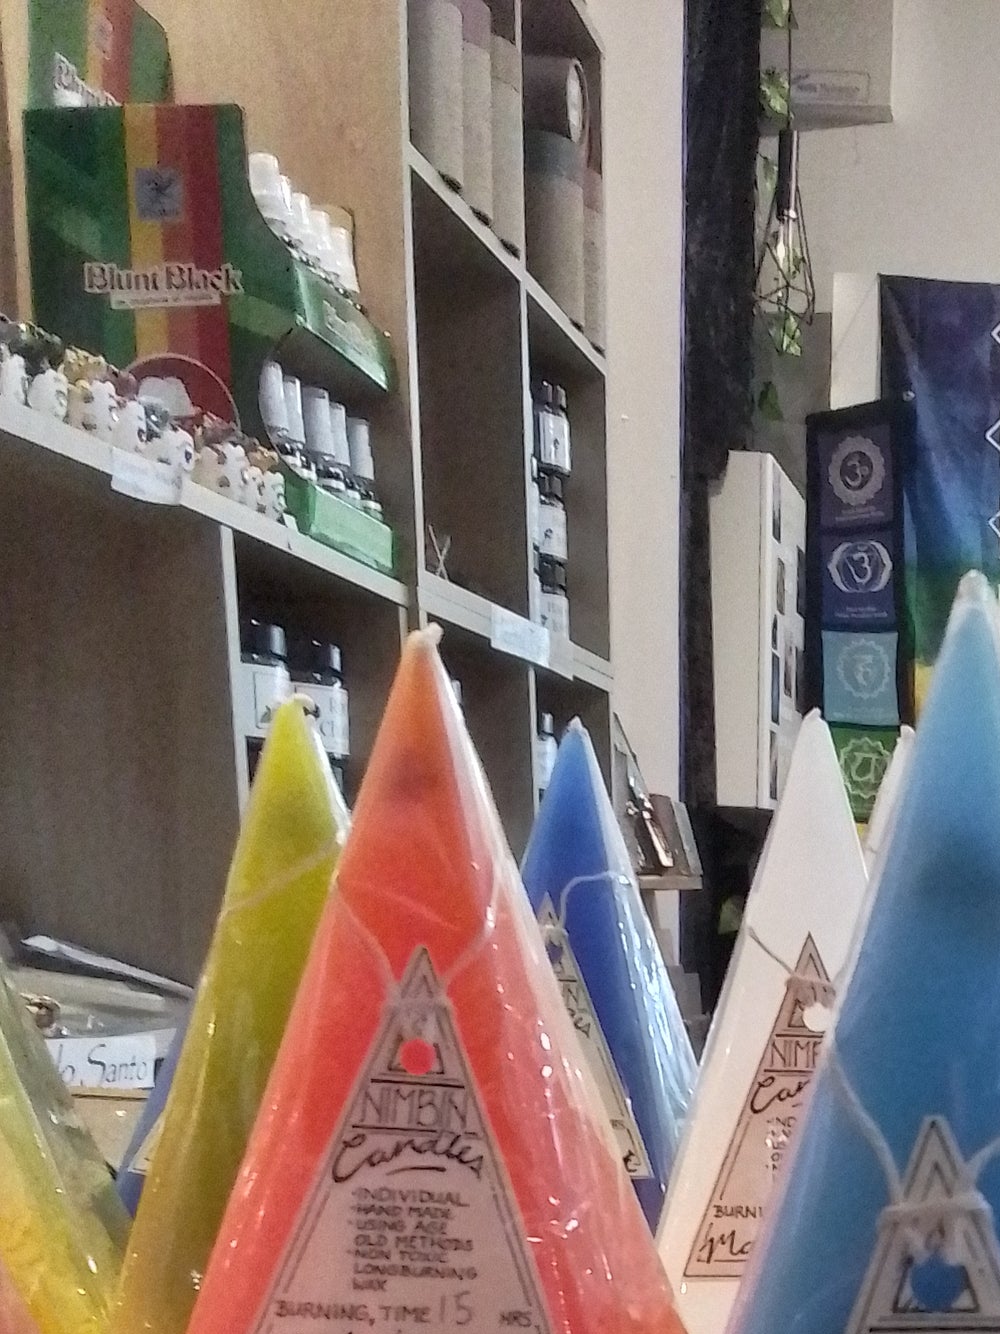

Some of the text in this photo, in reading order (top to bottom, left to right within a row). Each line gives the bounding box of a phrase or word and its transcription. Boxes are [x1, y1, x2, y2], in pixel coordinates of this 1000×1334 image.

[87, 1043, 147, 1084] Santo
[360, 1086, 468, 1129] NIMBIN
[331, 1133, 484, 1183] Candles
[713, 1203, 763, 1219] BURNI
[354, 1234, 389, 1247] OLD
[380, 1303, 431, 1323] TIME
[439, 1289, 473, 1326] 15
[500, 1310, 533, 1328] HRS
